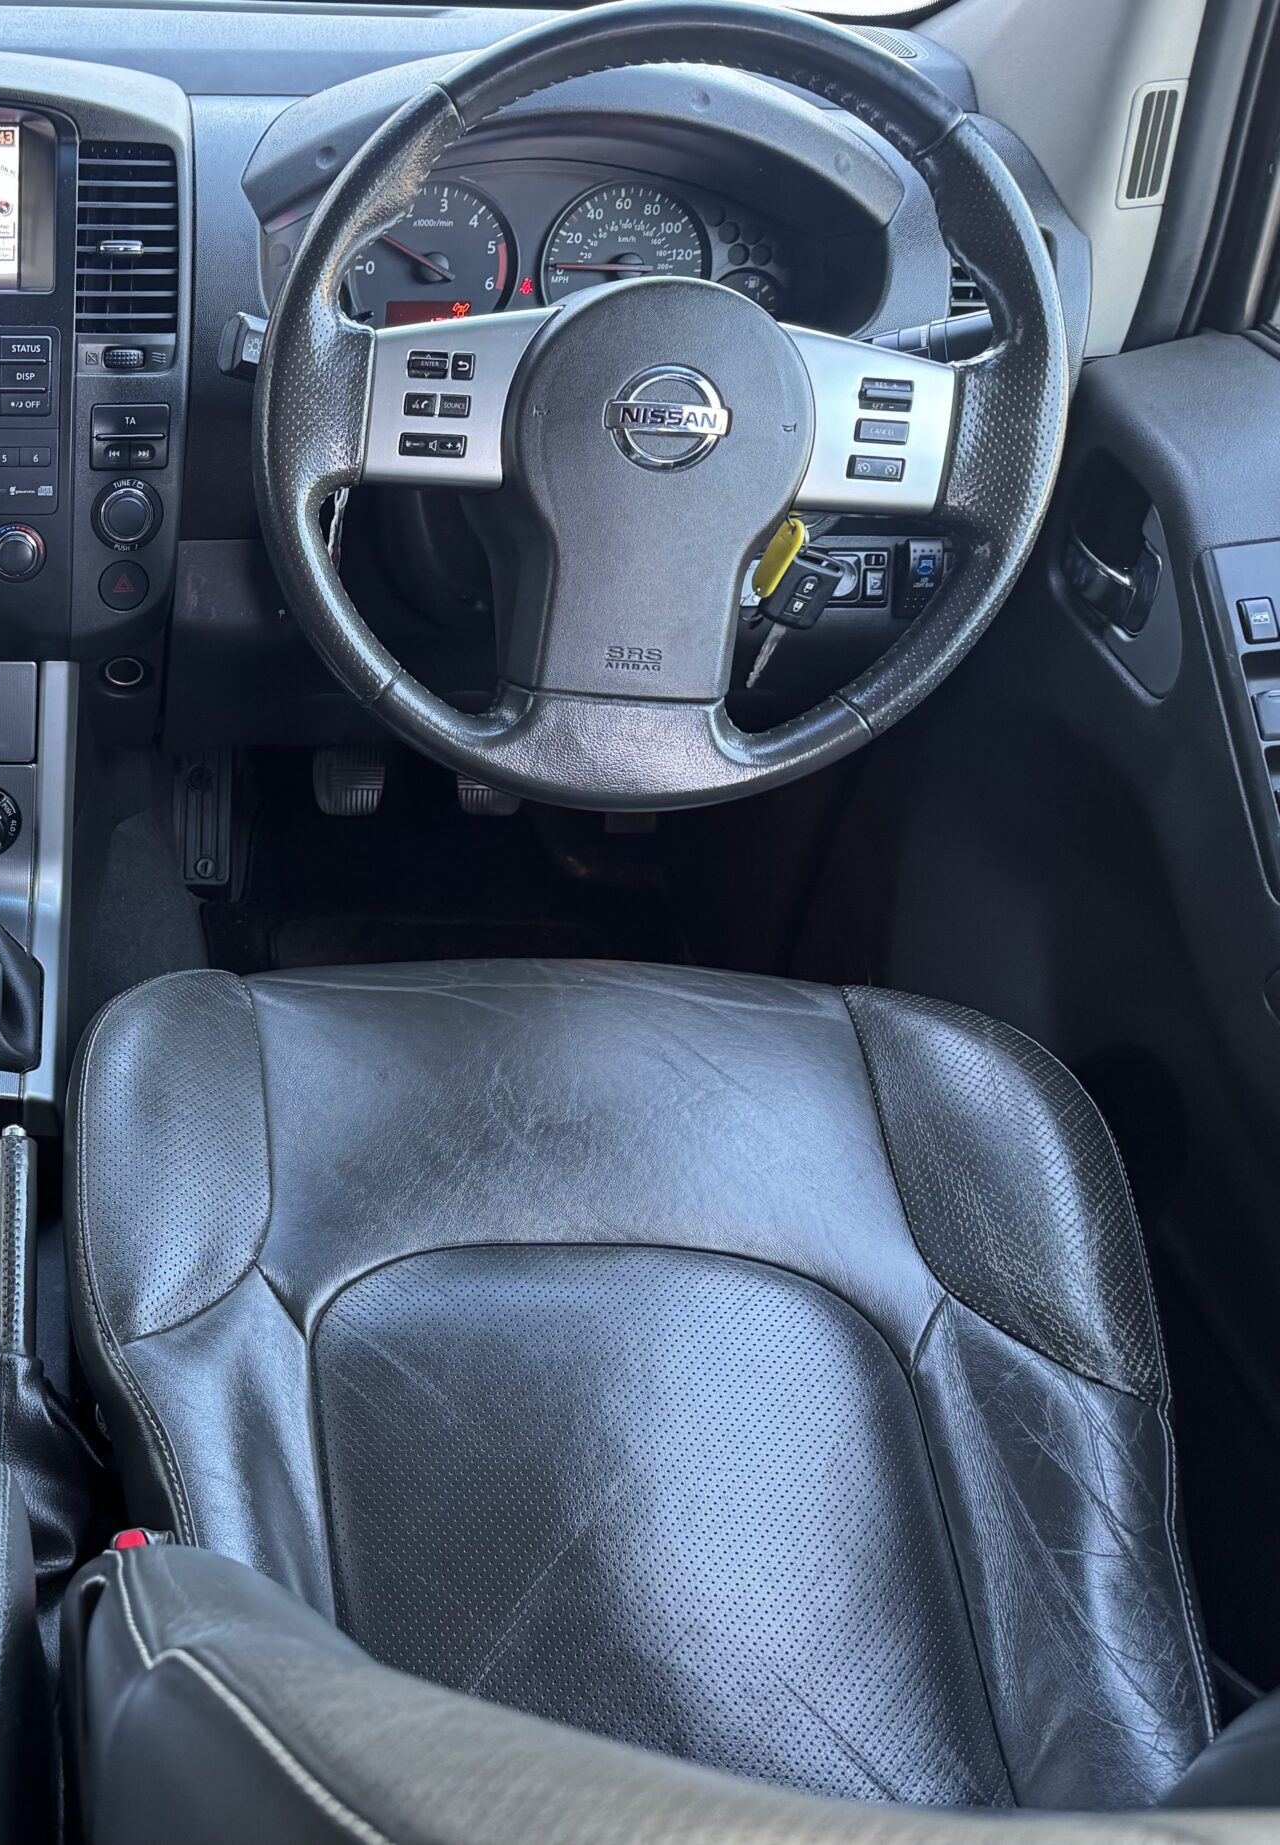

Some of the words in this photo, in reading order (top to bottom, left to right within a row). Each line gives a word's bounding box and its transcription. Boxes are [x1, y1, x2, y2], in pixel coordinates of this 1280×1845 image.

[439, 199, 449, 213] 3
[615, 198, 632, 210] 60
[643, 203, 661, 216] 80
[586, 208, 604, 220] 40
[469, 214, 479, 228] 4
[660, 222, 682, 234] 100
[566, 232, 583, 244] 20
[618, 235, 636, 243] km/h
[487, 240, 496, 254] 5
[672, 249, 693, 261] 120
[365, 260, 375, 275] 0
[484, 277, 494, 290] 6
[550, 275, 569, 284] MPH
[11, 344, 41, 353] STATUS
[16, 372, 36, 380] DISP
[443, 402, 465, 410] SOURCE
[124, 416, 136, 425] TA
[620, 407, 718, 429] NISSAN
[1, 454, 8, 463] 5
[33, 454, 39, 463] 6
[112, 479, 131, 489] TUNE
[113, 543, 130, 551] PUSH
[605, 645, 663, 661] SRS
[605, 662, 661, 672] AIRBAG
[1, 803, 13, 817] PUSH
